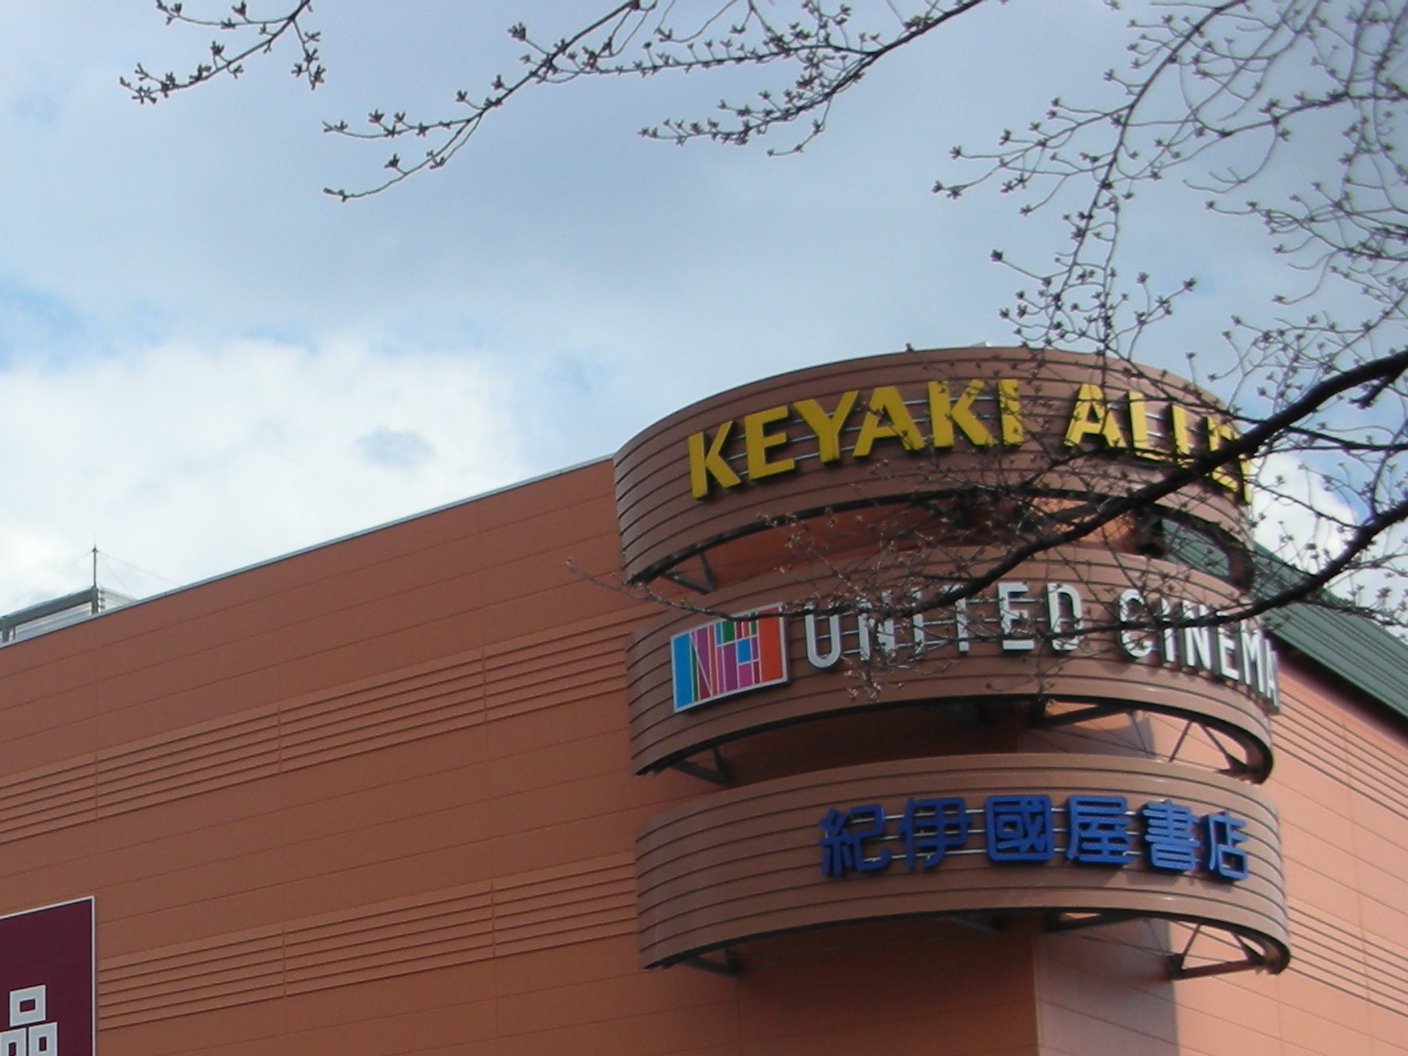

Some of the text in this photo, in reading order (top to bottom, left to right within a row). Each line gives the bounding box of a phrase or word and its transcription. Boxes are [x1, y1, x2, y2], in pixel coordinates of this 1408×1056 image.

[688, 379, 1025, 499] KEYAKI
[804, 581, 1085, 669] UNITED
[818, 793, 1249, 882] 紀伊國屋書店
